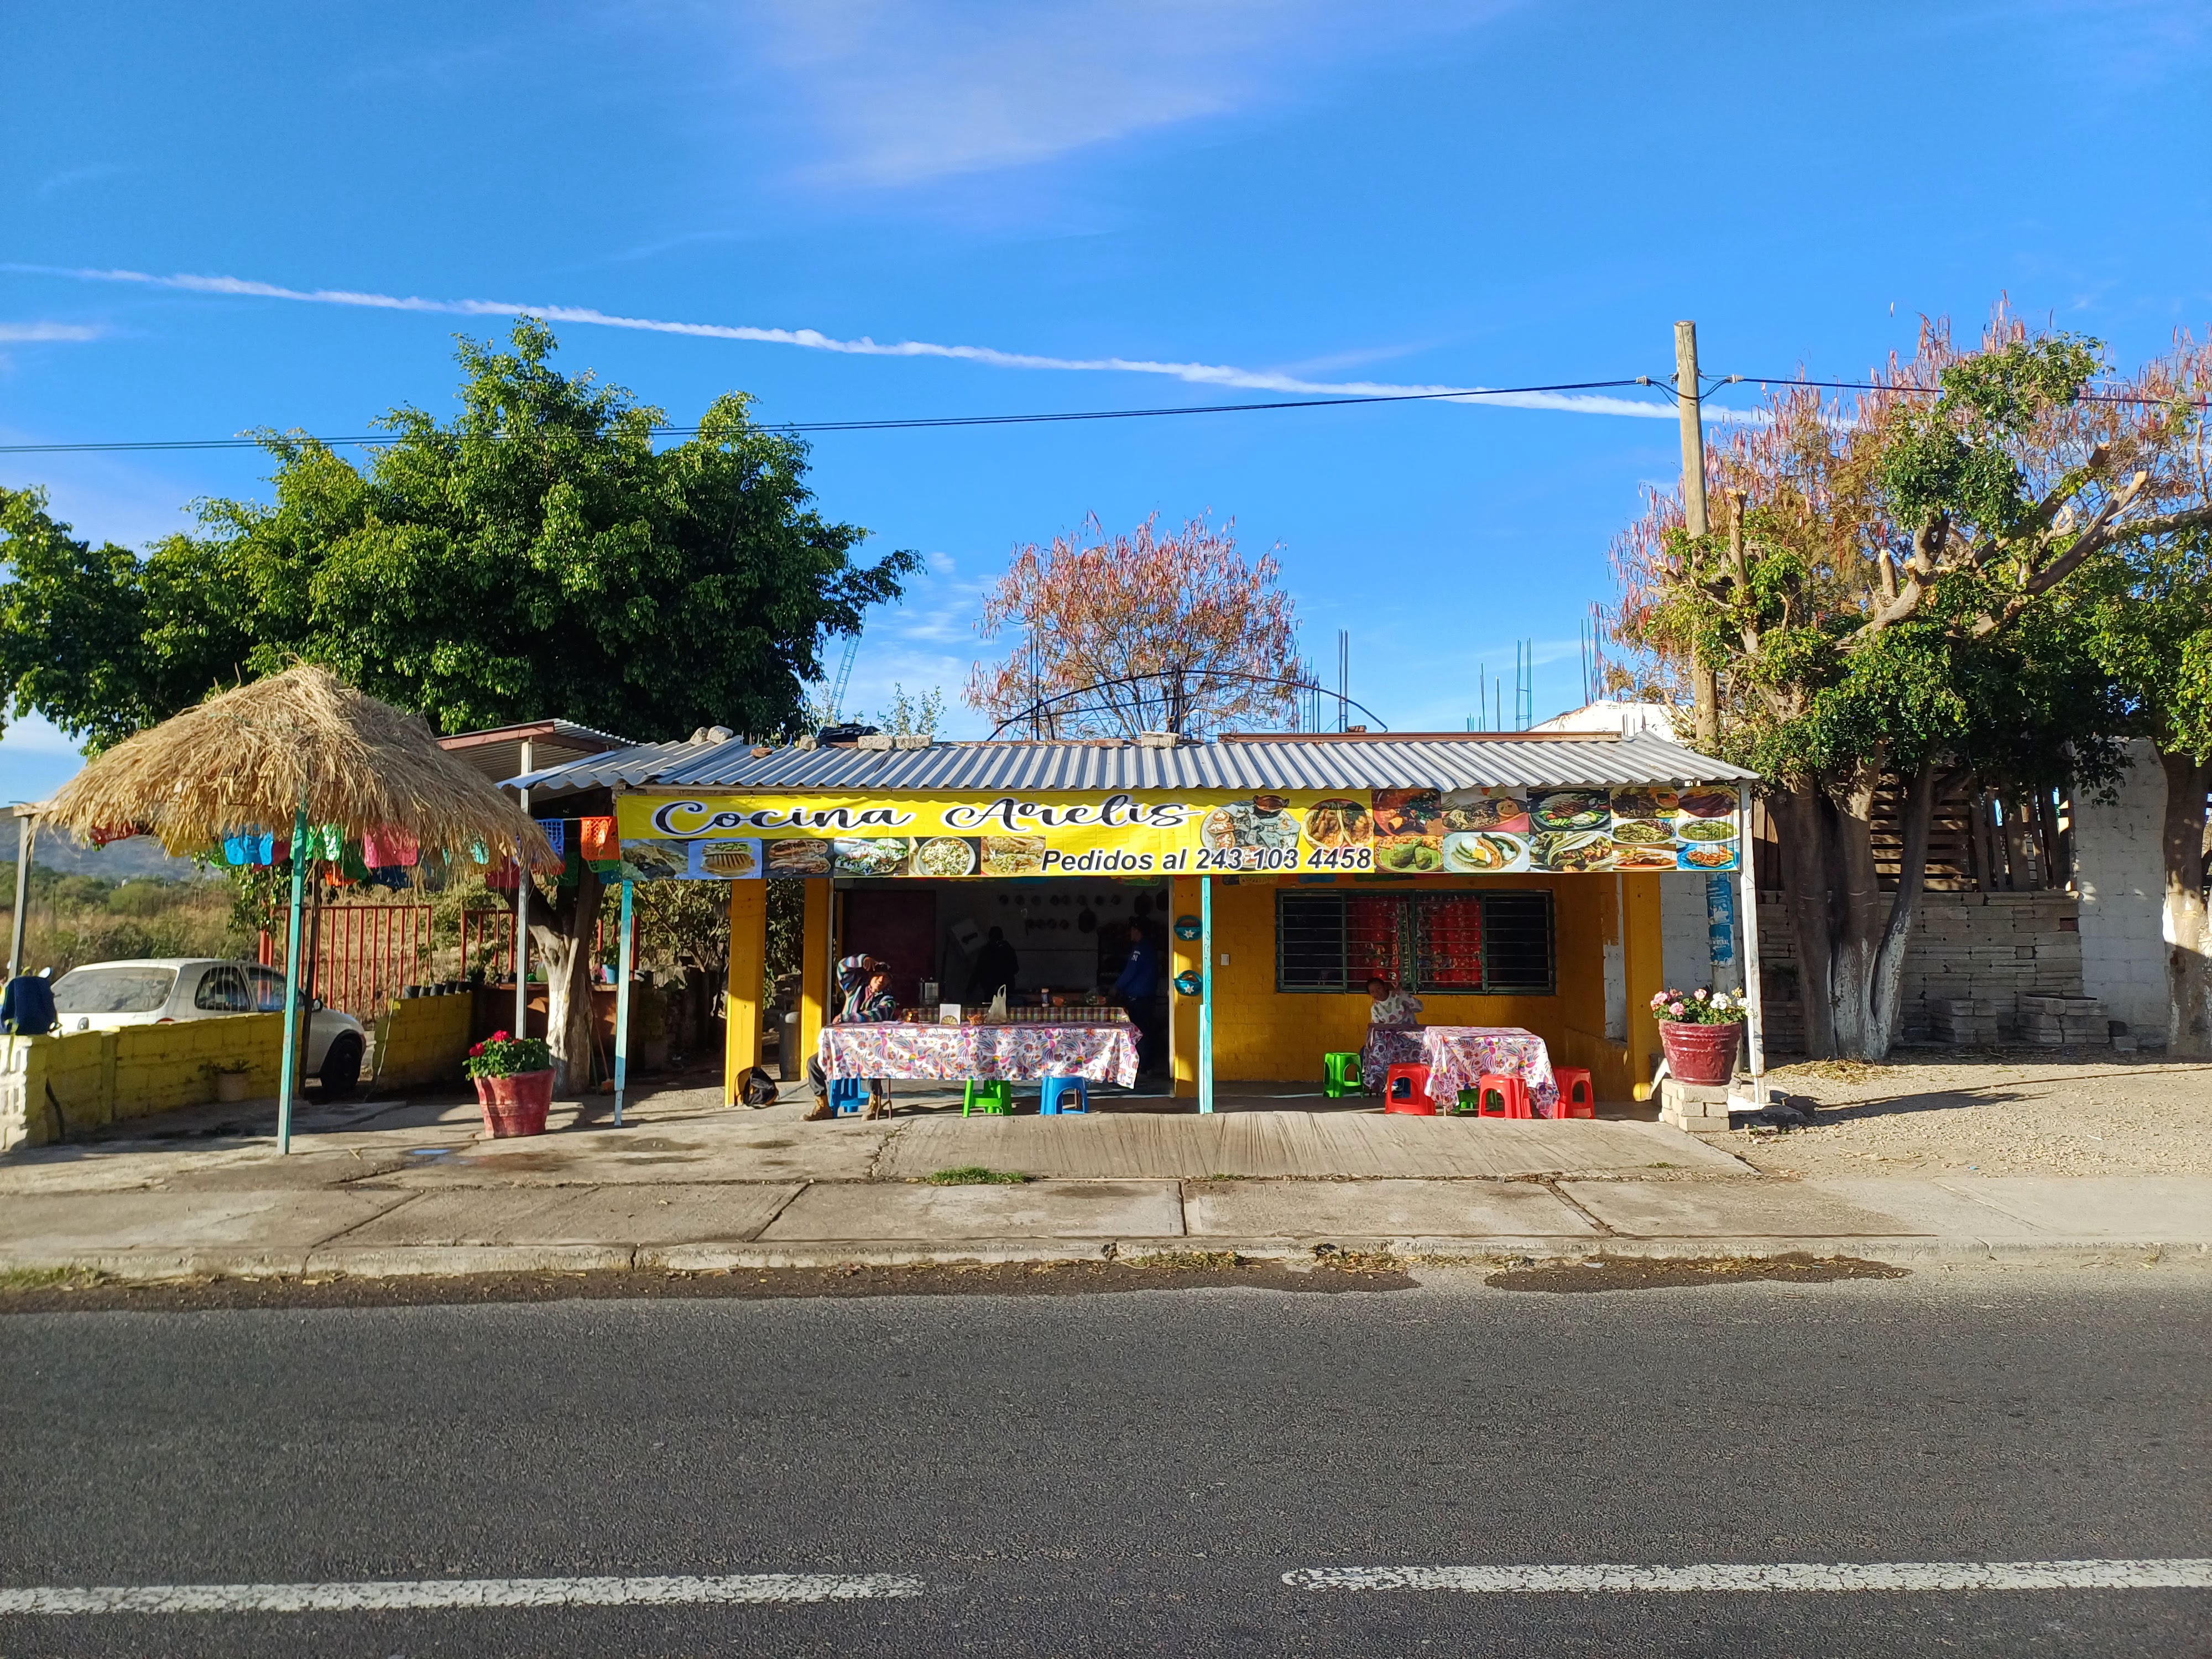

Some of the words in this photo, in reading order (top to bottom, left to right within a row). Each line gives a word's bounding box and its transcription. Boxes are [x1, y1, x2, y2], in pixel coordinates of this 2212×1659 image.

[653, 800, 913, 836] Cocina
[943, 793, 1202, 832] Arelis
[1041, 849, 1154, 871] Pedidos
[1162, 848, 1187, 870] al
[1196, 848, 1243, 870] 243
[1251, 848, 1298, 870] 103
[1307, 848, 1371, 869] 4458
